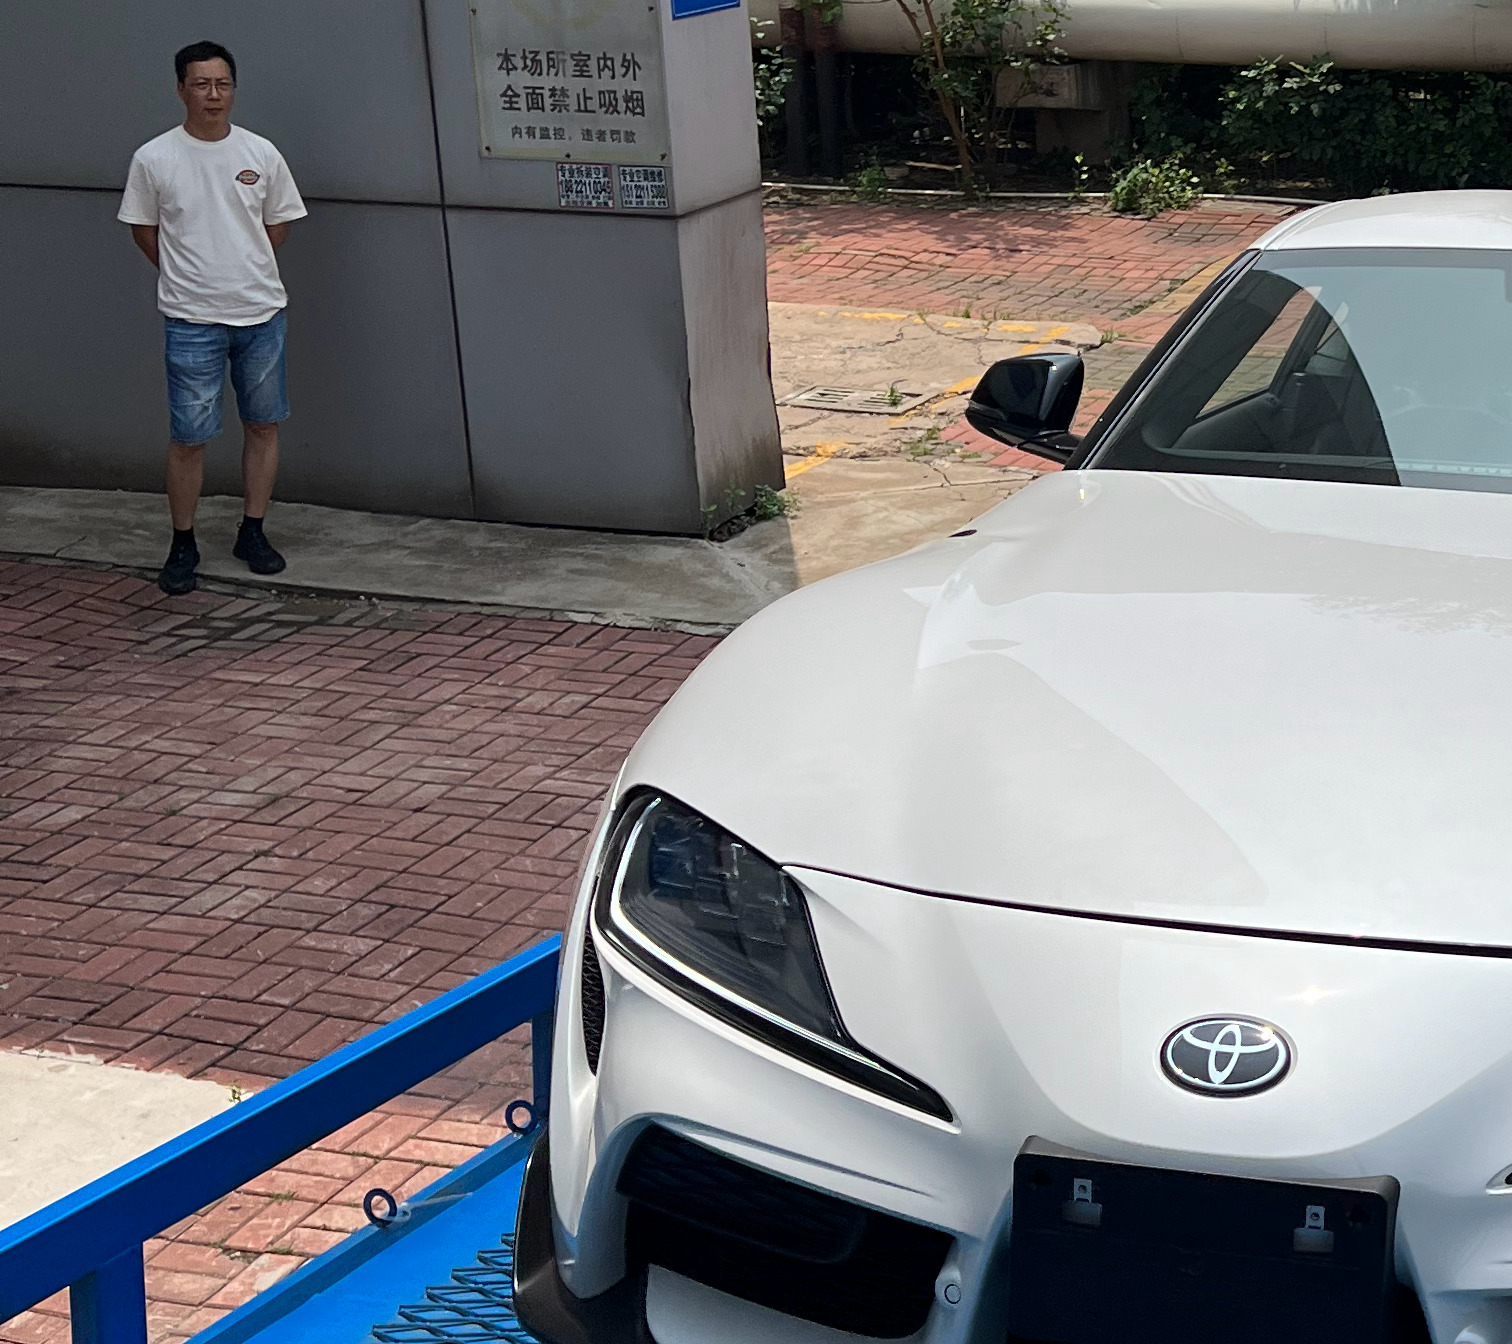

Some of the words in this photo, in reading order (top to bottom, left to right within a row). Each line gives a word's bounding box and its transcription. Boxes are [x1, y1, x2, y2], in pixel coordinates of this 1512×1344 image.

[496, 48, 642, 81] 本场所室内外
[499, 84, 646, 117] 全面禁止吸烟
